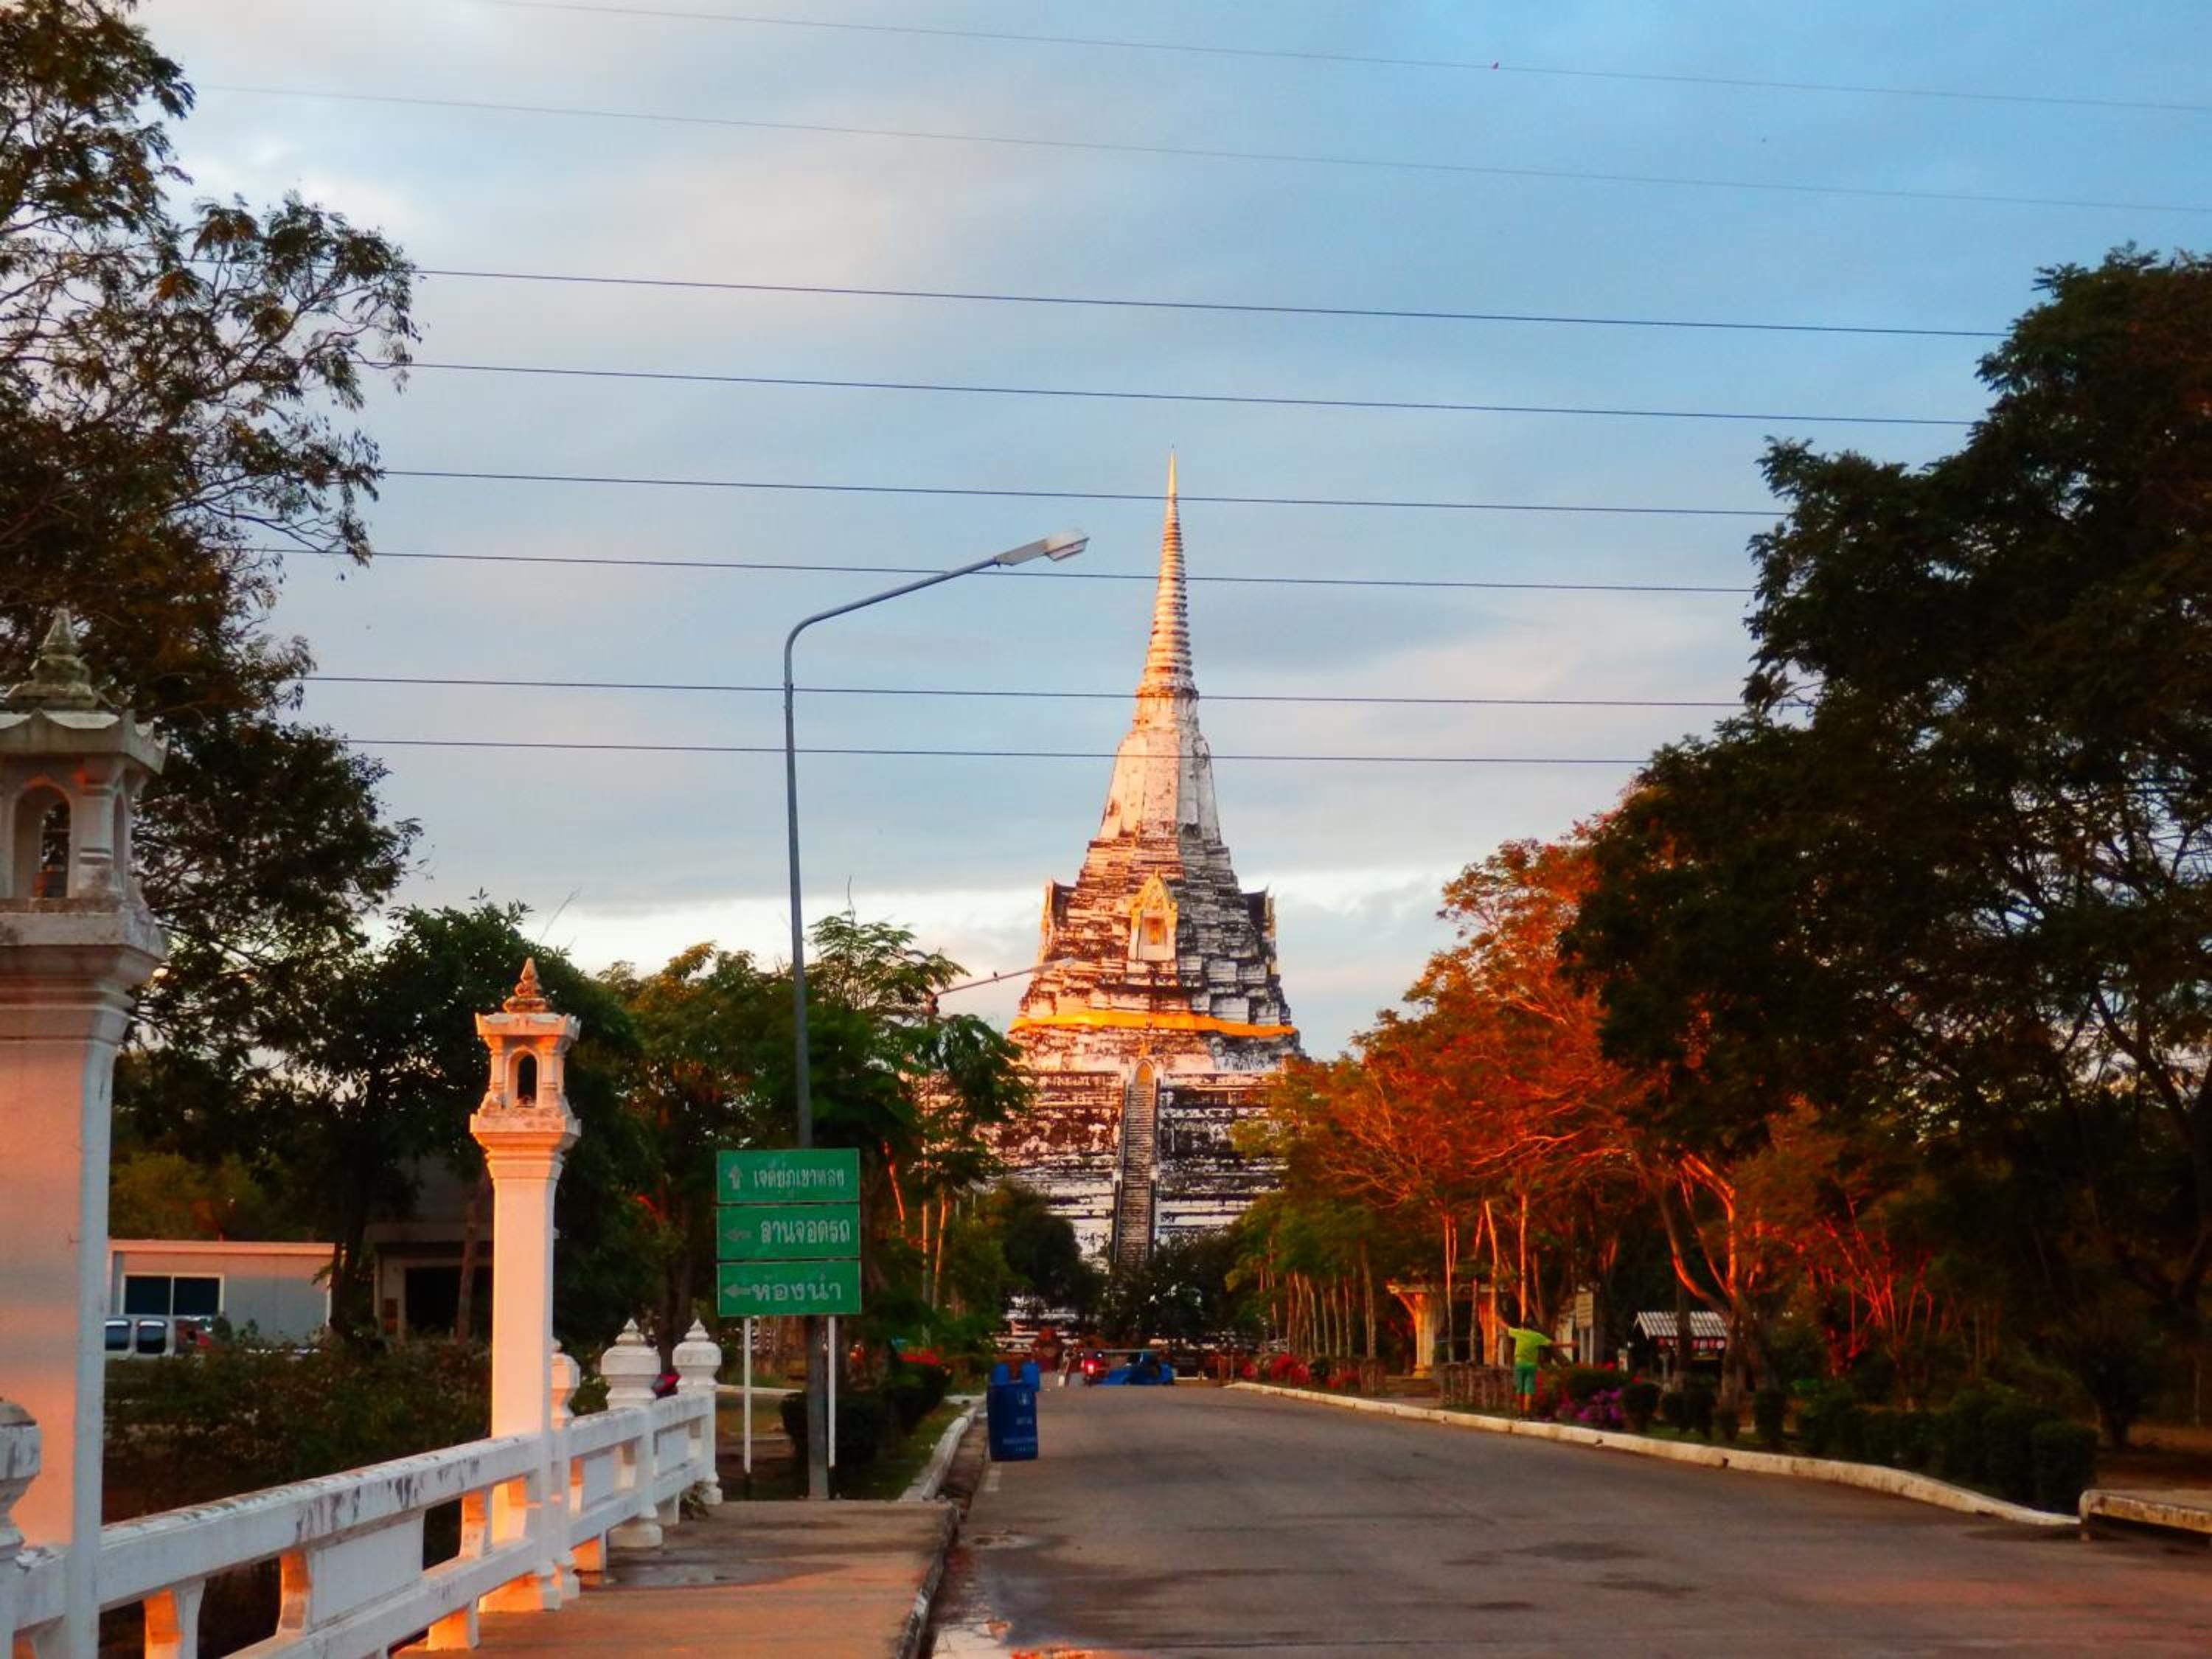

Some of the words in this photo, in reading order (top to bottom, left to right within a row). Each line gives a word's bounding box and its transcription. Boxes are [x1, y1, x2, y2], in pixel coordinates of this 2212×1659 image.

[760, 1220, 849, 1243] ลานจอดรถ
[752, 1267, 842, 1301] ห้องน้ำ
